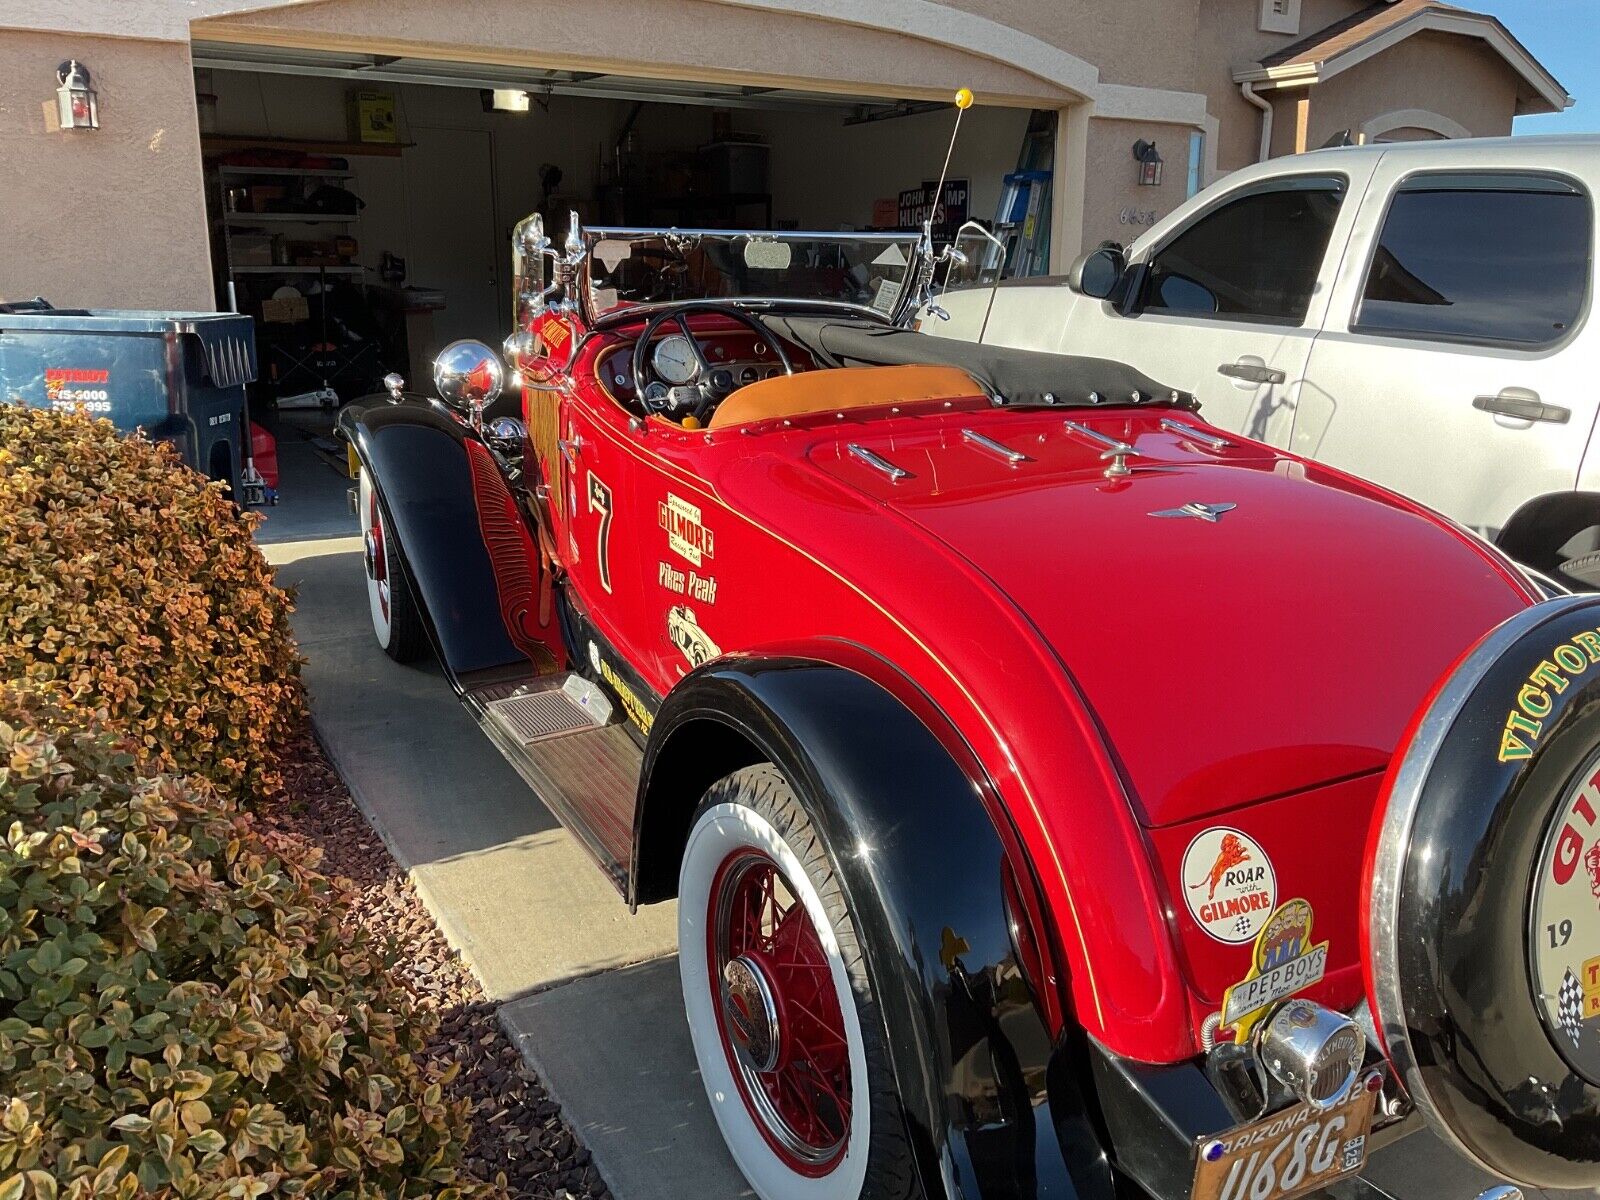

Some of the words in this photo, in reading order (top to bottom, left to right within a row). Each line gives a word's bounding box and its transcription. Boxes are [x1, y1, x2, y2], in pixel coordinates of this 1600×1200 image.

[900, 189, 926, 207] JOHN
[899, 203, 945, 226] HUGHES
[46, 368, 109, 384] PATRIOT
[660, 502, 713, 558] GILMORE
[658, 561, 686, 595] Pikes
[688, 569, 718, 605] Peak
[1225, 866, 1265, 887] ROAR
[1236, 883, 1262, 894] with
[1199, 891, 1270, 924] GILMORE
[1547, 918, 1573, 949] 19
[1248, 971, 1280, 1000] PEP
[1284, 950, 1323, 983] BOYS
[1271, 984, 1291, 996] Moe
[1316, 1036, 1357, 1067] PLYMOUTH
[1219, 1115, 1346, 1200] 1168G
